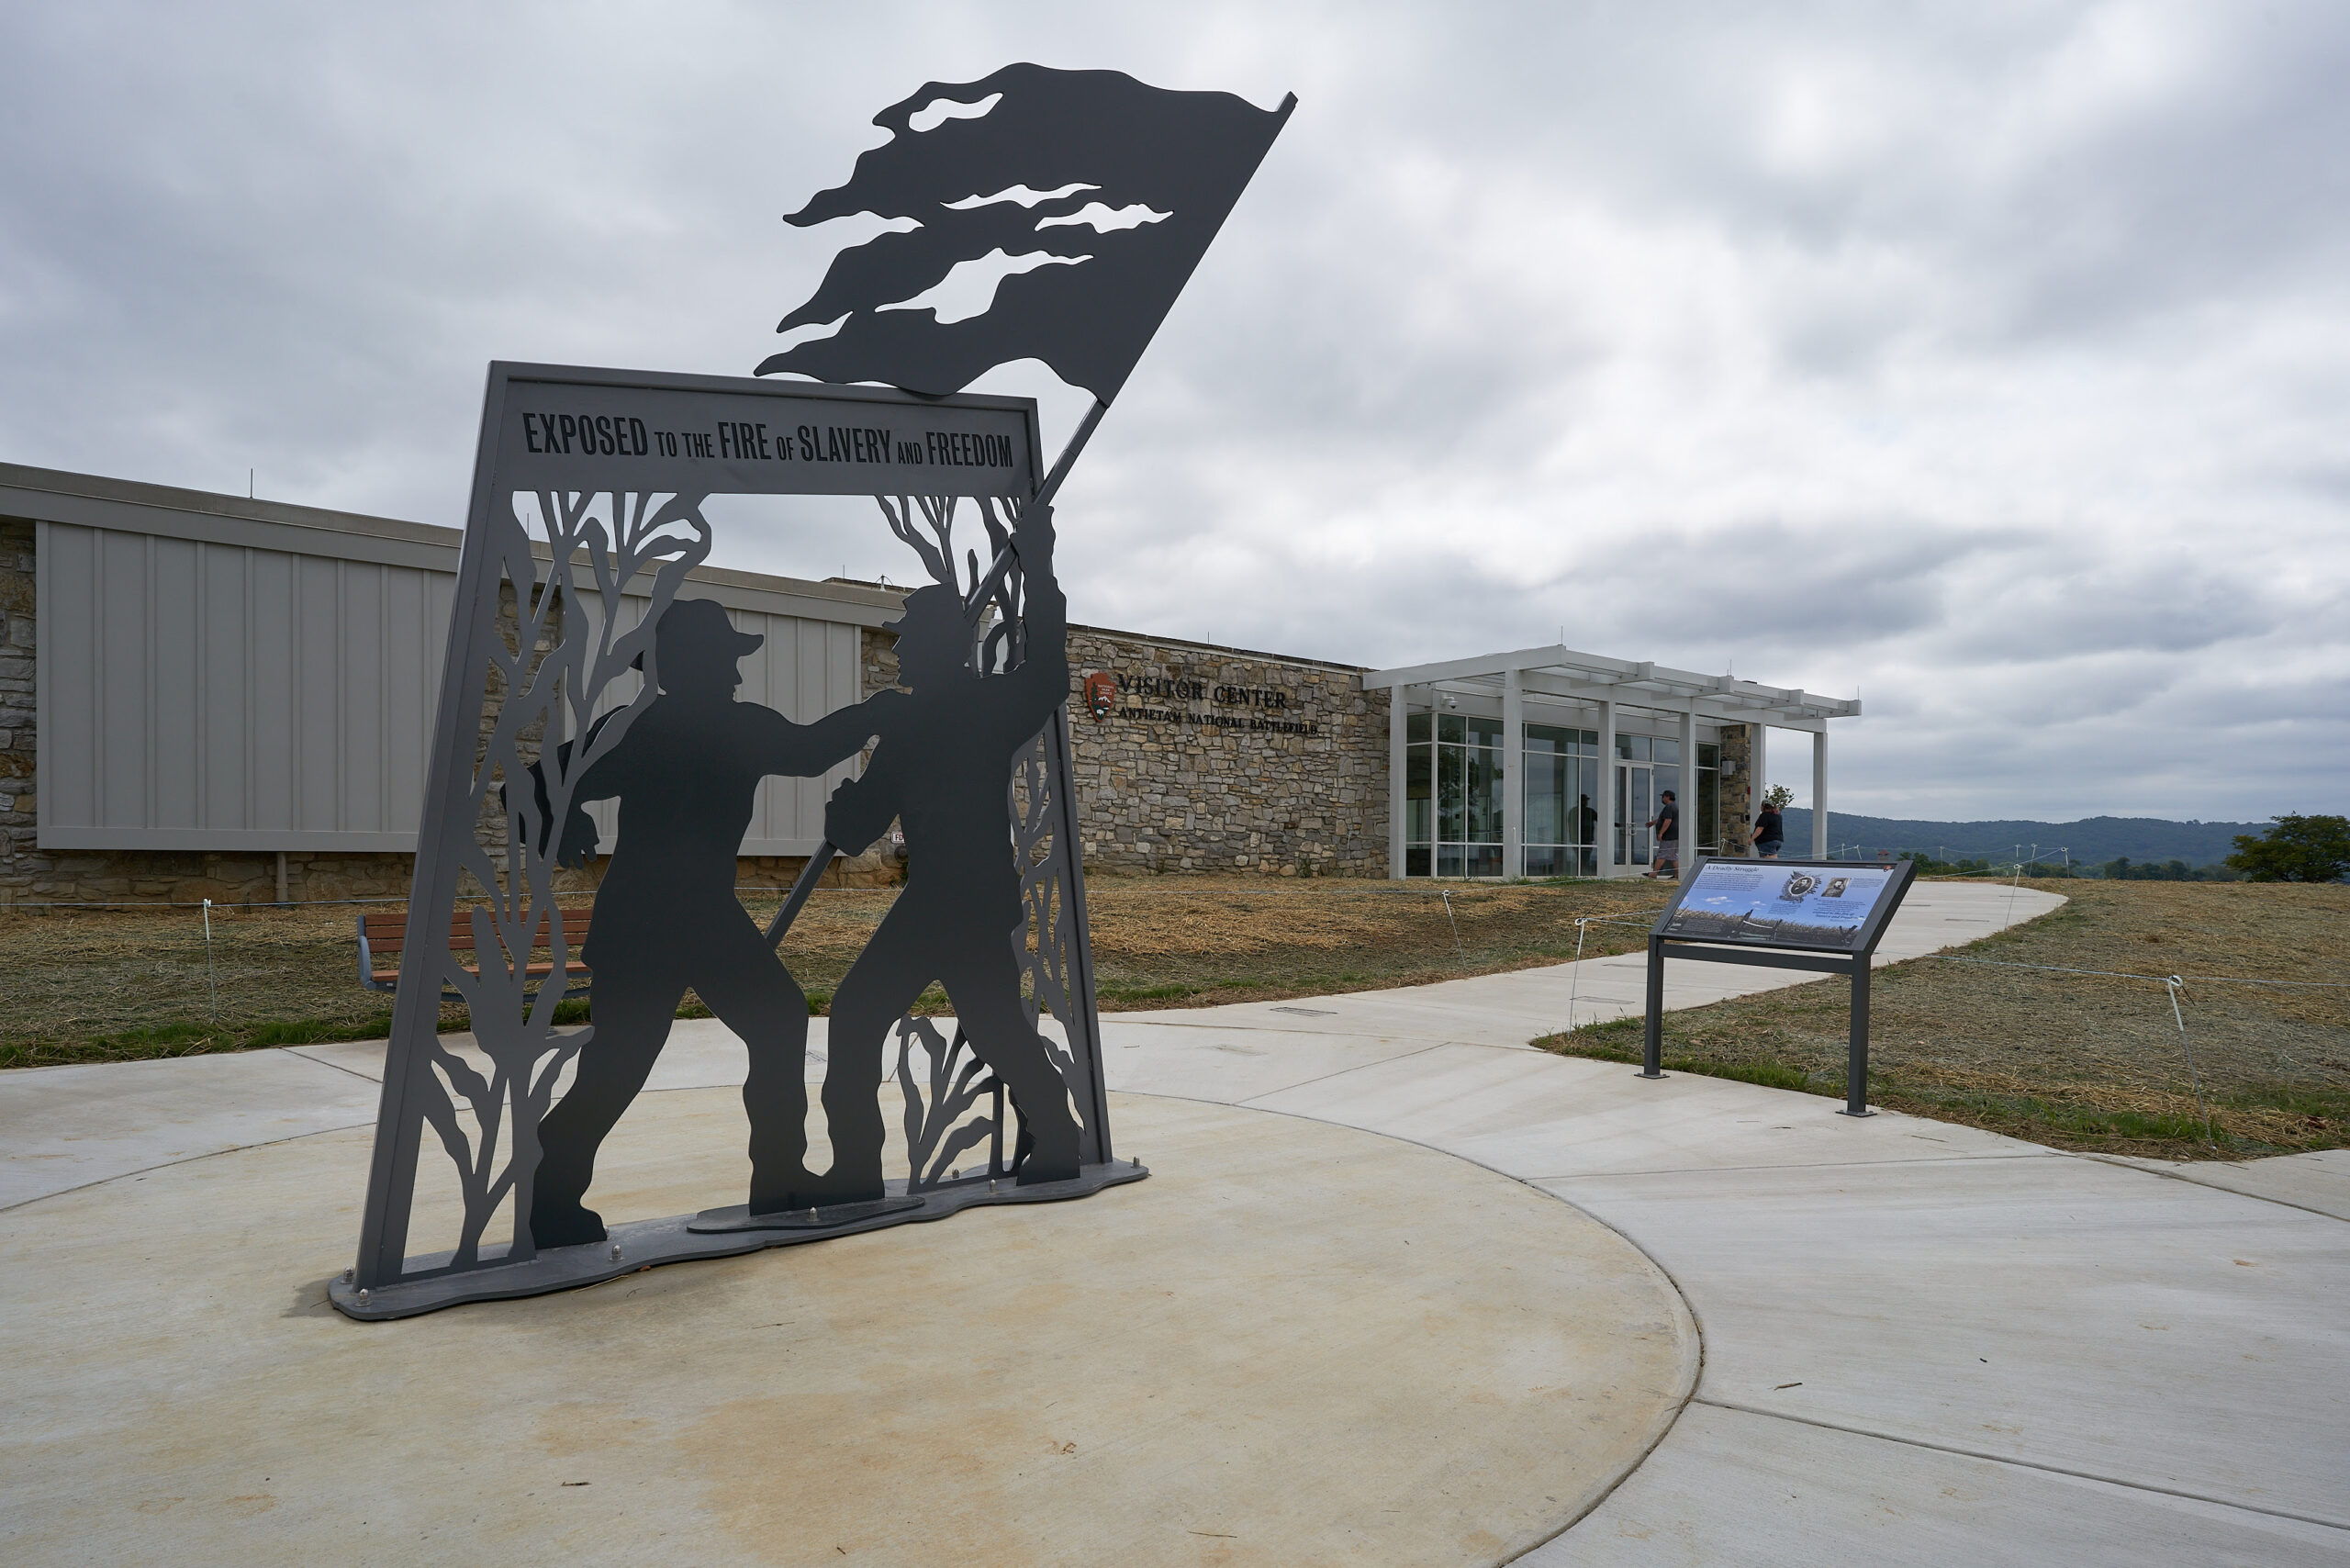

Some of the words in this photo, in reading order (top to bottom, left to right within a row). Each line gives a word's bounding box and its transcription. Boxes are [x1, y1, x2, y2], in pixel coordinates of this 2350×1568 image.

[522, 412, 648, 456] EXPOSED
[654, 431, 677, 457] TO
[681, 432, 715, 459] THE
[718, 421, 772, 460] FIRE
[776, 436, 794, 461] OF
[797, 425, 890, 464] SLAVERY
[898, 442, 923, 465] AND
[925, 431, 1013, 468] FREEDOM
[1118, 673, 1203, 700] VISITOR
[1214, 686, 1286, 709] CENTER
[1119, 706, 1181, 723] ANTIETAM
[1188, 713, 1245, 729] NATIONAL
[1250, 719, 1318, 734] BATTLEFIELD
